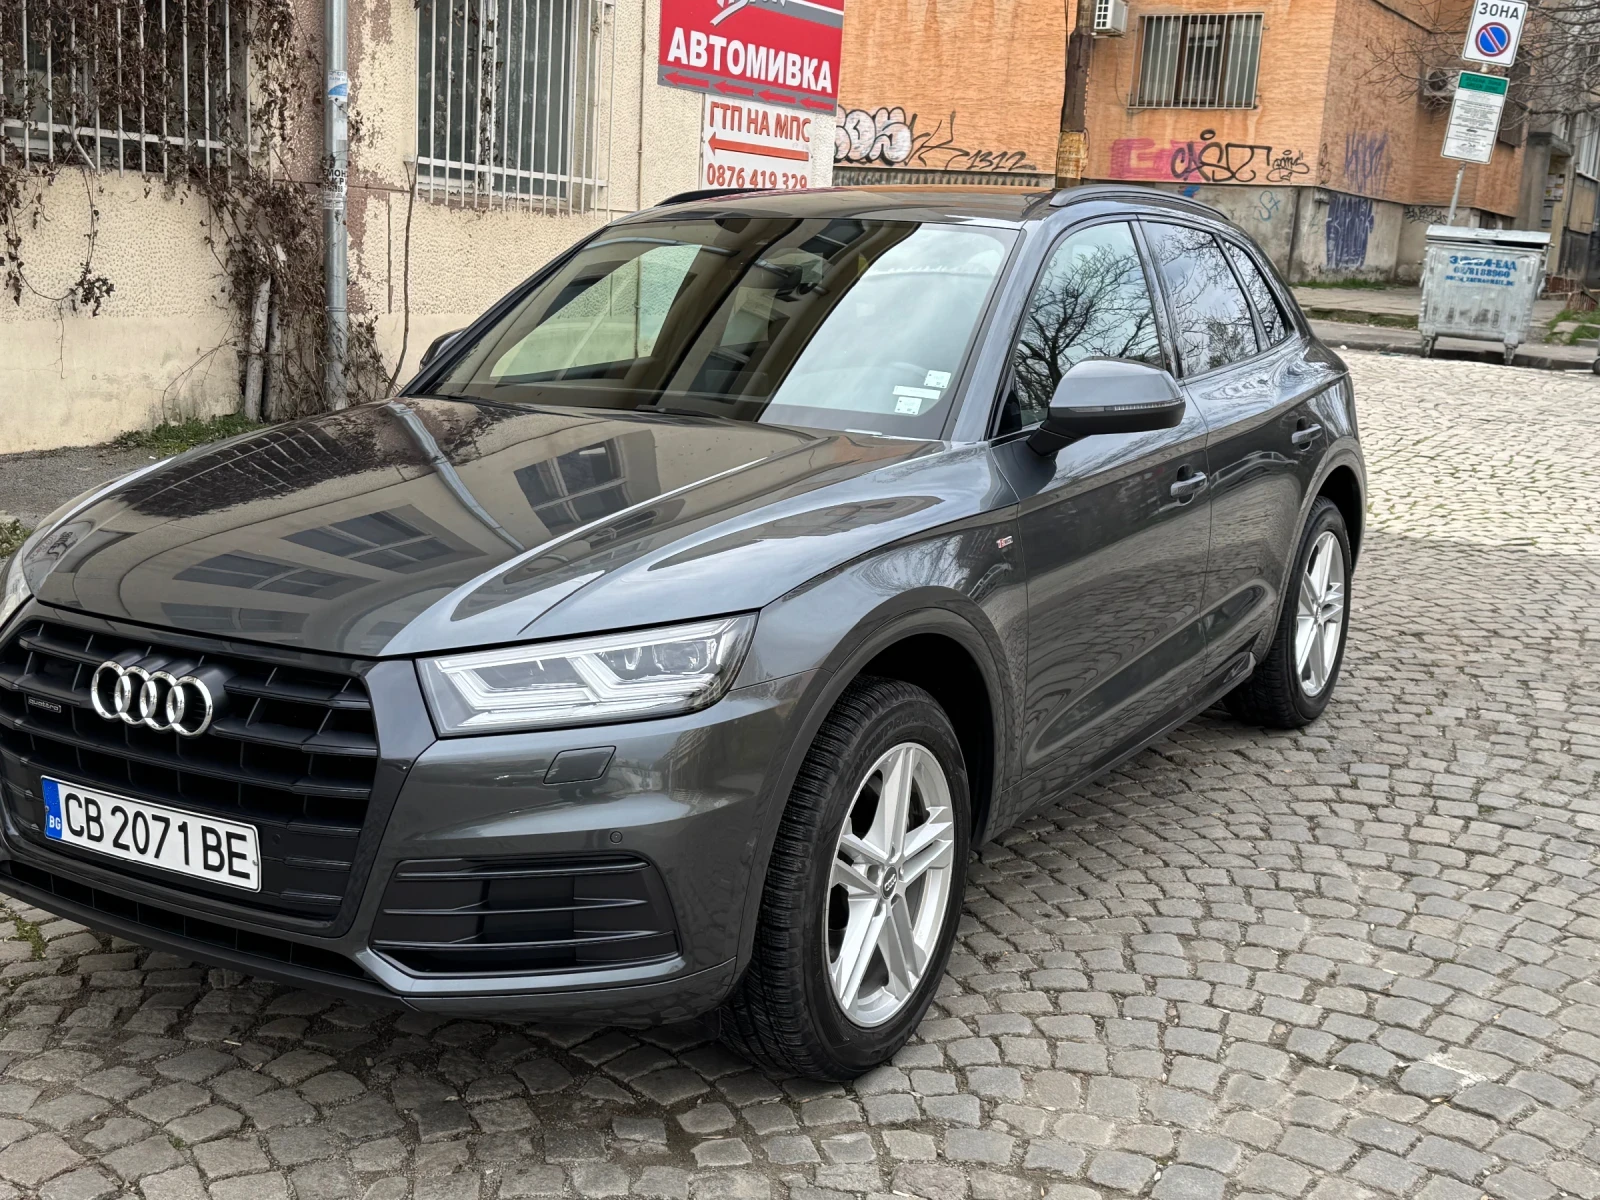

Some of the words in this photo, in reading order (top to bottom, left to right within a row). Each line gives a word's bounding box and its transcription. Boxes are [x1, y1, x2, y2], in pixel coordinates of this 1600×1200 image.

[1478, 2, 1520, 20] ЗОНА
[667, 26, 833, 94] АВТОМИВКА
[709, 101, 743, 132] ГТП
[746, 108, 770, 137] НА
[774, 113, 812, 143] МПС
[706, 163, 746, 188] 0876
[749, 169, 778, 189] 419
[49, 815, 62, 831] BG
[64, 792, 105, 843] CB
[110, 805, 191, 866] 2071
[200, 825, 251, 880] BE
